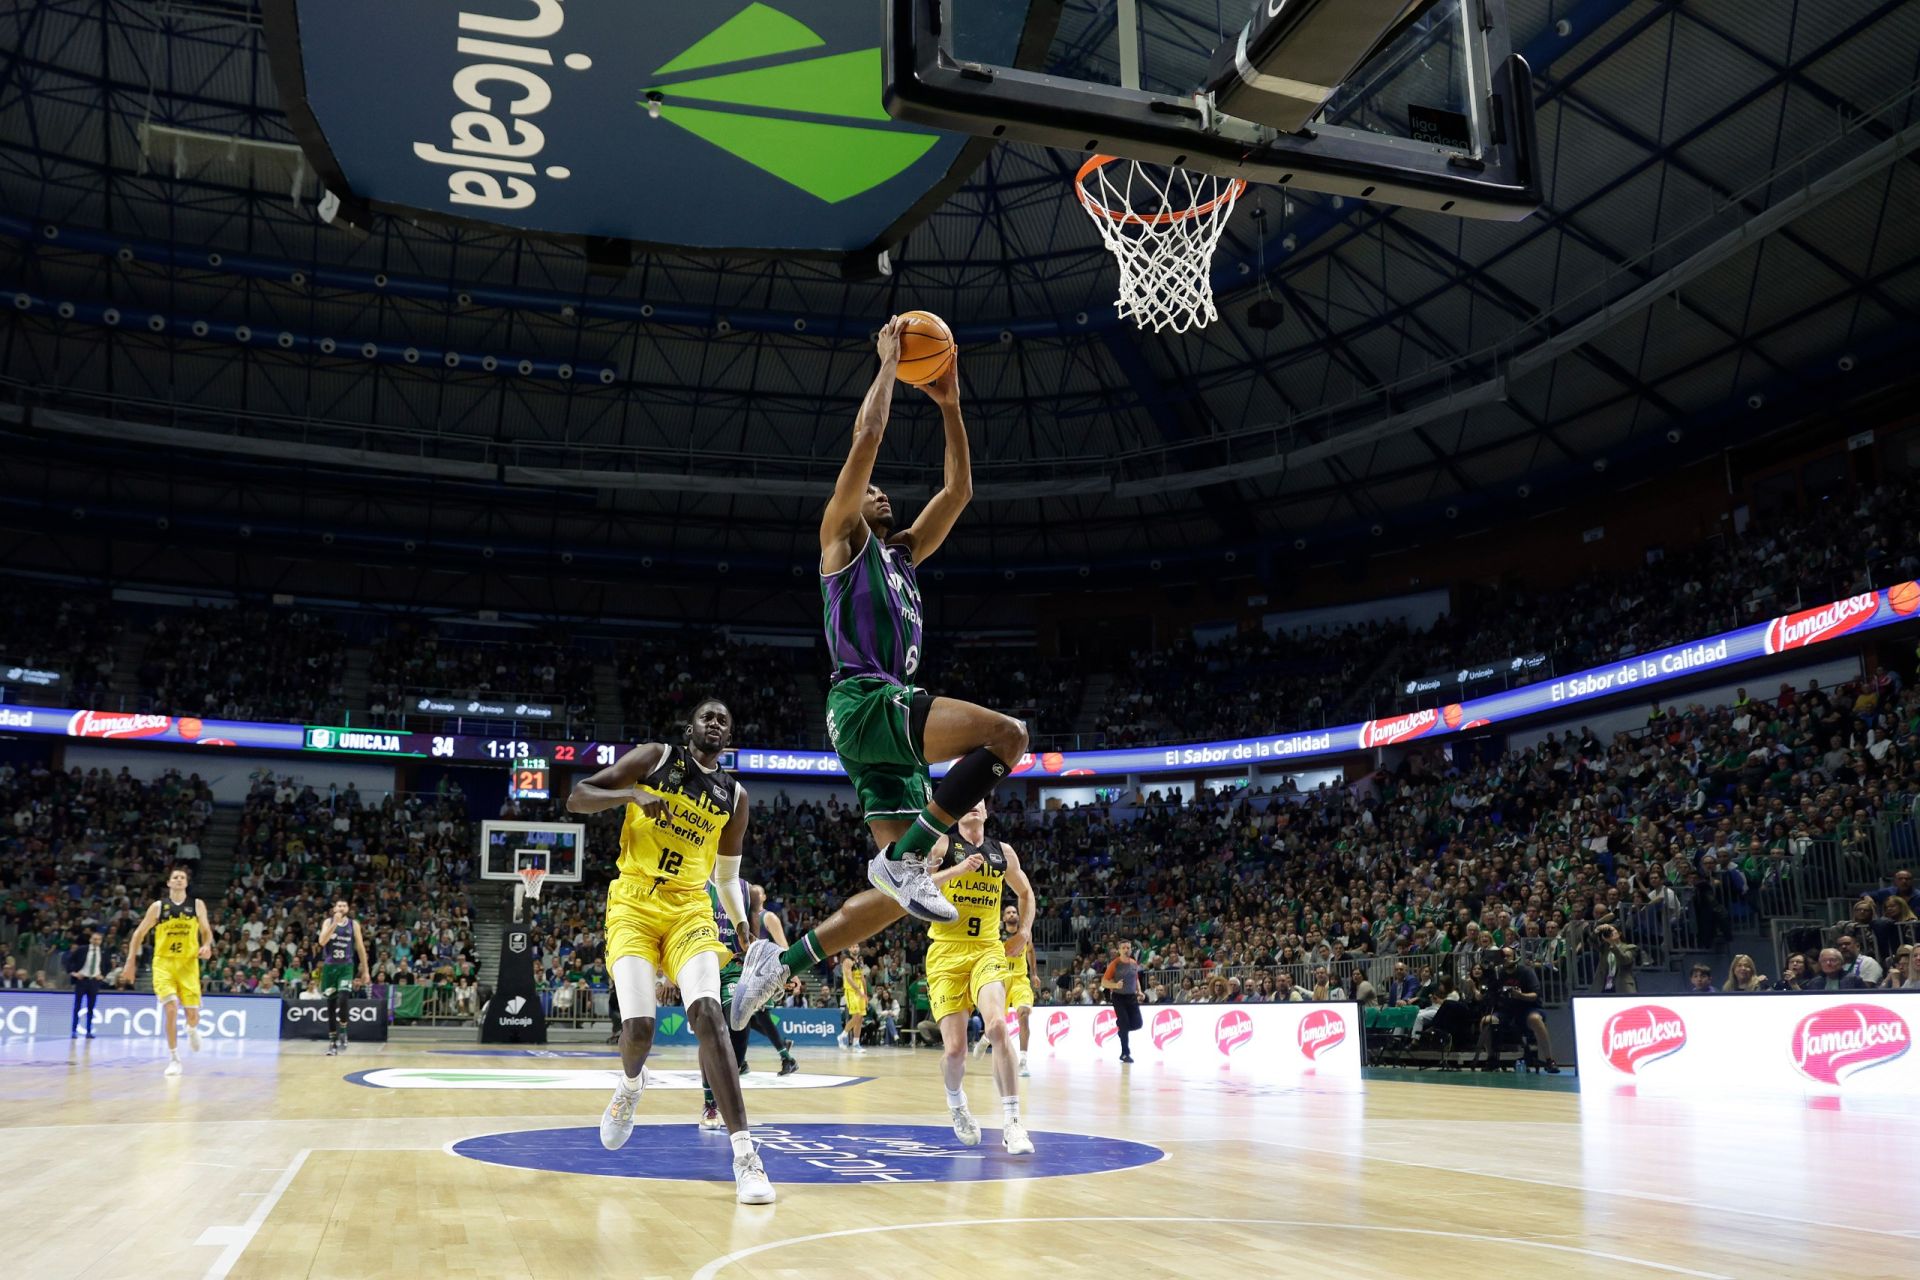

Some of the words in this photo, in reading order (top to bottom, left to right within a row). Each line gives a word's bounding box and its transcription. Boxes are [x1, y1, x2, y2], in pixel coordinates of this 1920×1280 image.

[905, 645, 918, 675] 6
[1552, 683, 1565, 702] El
[1569, 674, 1614, 697] Sabor
[1617, 665, 1638, 685] de
[1642, 660, 1657, 678] la
[1661, 640, 1727, 673] Calidad
[339, 733, 400, 751] UNICAJA
[432, 736, 454, 757] 34
[487, 741, 529, 758] 1:13
[1166, 751, 1179, 766] El
[1184, 748, 1229, 765] Sabor
[1233, 744, 1251, 760] de
[1257, 742, 1270, 757] la
[1274, 734, 1330, 755] Calidad
[555, 746, 575, 760] 22
[597, 745, 615, 764] 31
[523, 759, 545, 768] 1:13
[750, 755, 763, 768] El
[767, 755, 814, 770] Sabor
[817, 756, 838, 771] de
[520, 771, 543, 789] 21
[658, 847, 683, 875] 12
[949, 880, 962, 889] LA
[967, 917, 981, 936] 9
[169, 942, 182, 953] 42
[332, 949, 345, 959] 33
[287, 1006, 377, 1022] endsa
[499, 1016, 532, 1027] Unicaja
[782, 1020, 835, 1037] Unicaja
[1606, 1009, 1683, 1060] famadesa
[1798, 1009, 1905, 1068] famadesa
